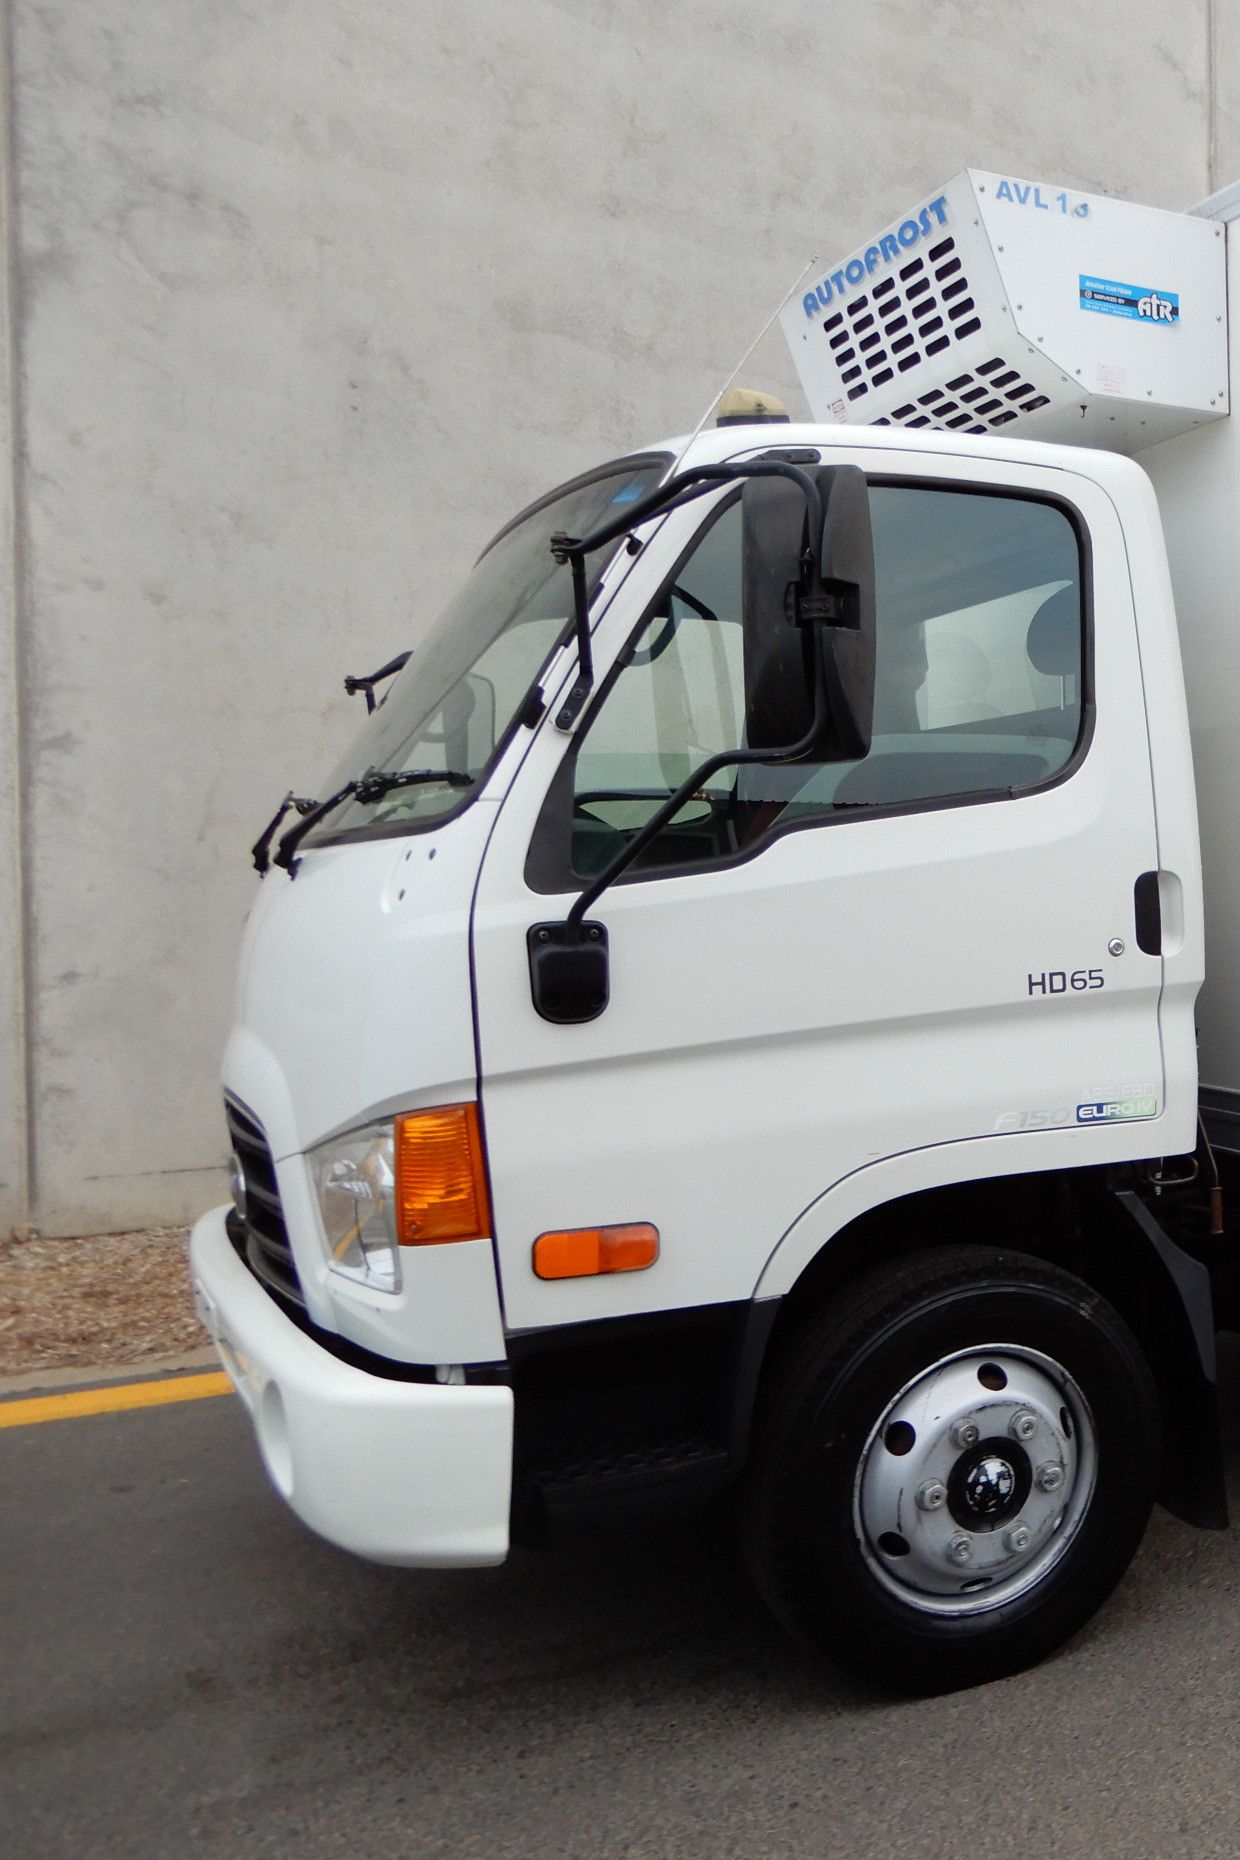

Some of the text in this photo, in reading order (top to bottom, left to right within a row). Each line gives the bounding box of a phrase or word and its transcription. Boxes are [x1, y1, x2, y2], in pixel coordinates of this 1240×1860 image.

[996, 180, 1048, 209] AVL
[803, 195, 947, 318] AUTOFROST
[1028, 969, 1104, 995] HD65
[1078, 1102, 1135, 1119] EURO
